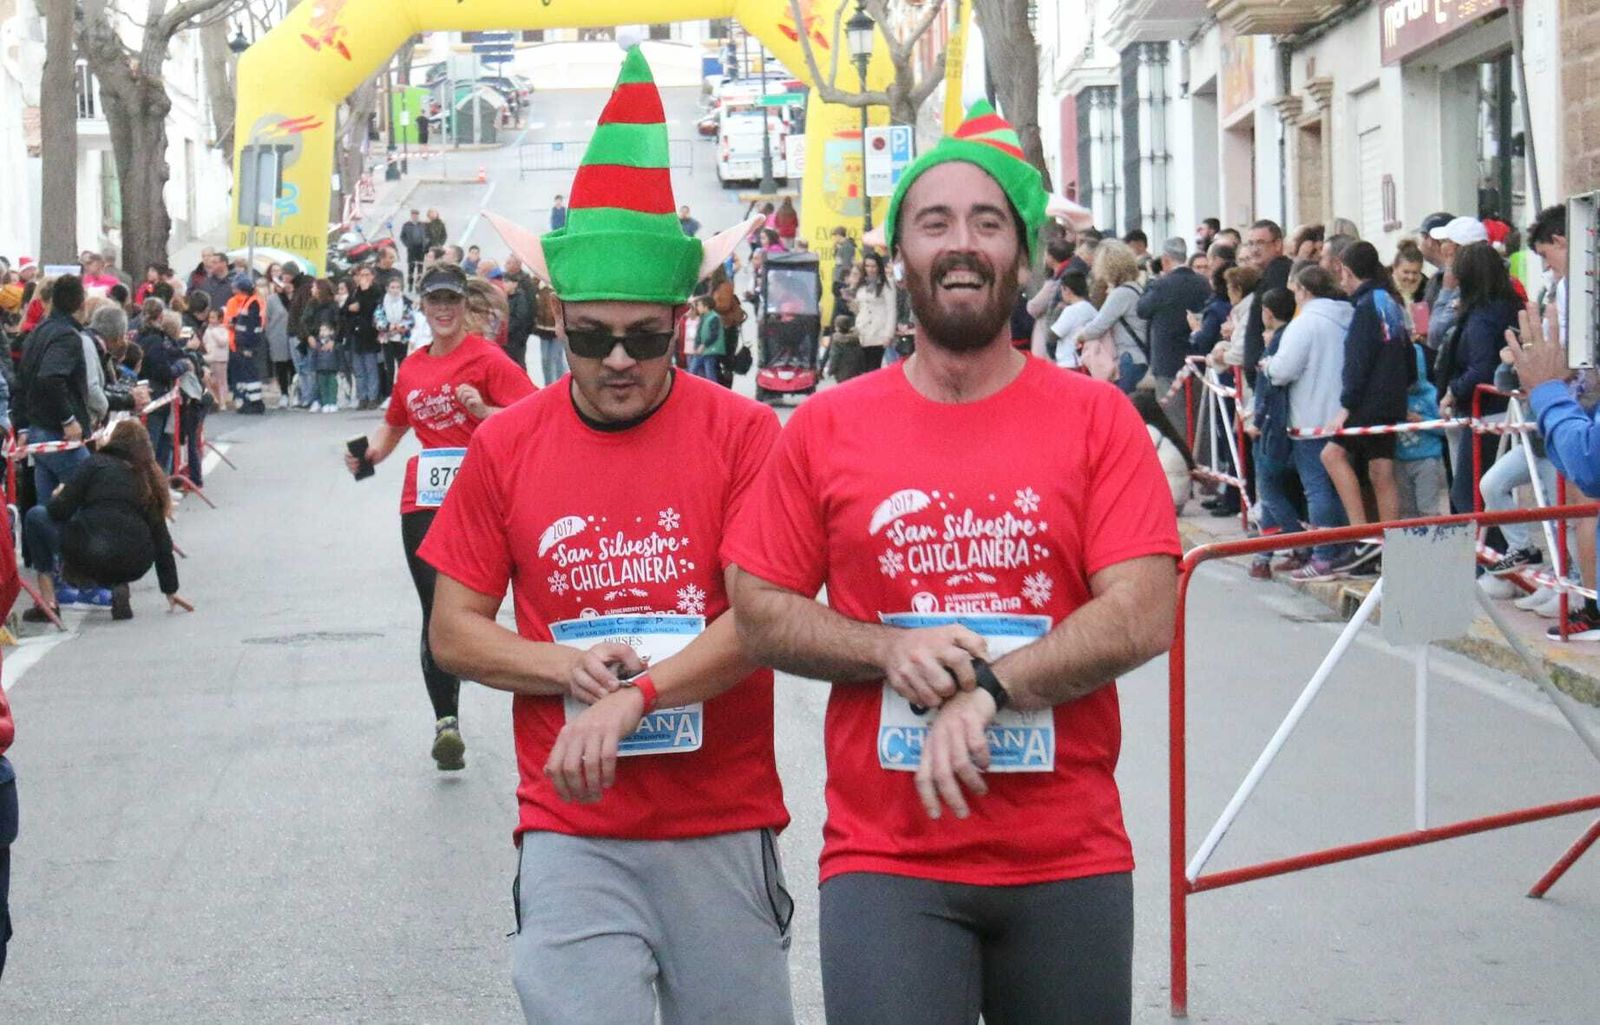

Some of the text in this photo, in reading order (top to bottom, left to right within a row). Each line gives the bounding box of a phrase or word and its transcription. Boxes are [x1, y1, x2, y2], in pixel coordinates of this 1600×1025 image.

[240, 230, 319, 250] DLEGACION
[553, 519, 573, 540] 2019
[893, 508, 1037, 547] San Silvestre
[558, 531, 679, 568] San Silvestre
[907, 538, 1030, 575] CHICLANERA
[571, 554, 678, 591] CHICLANERA
